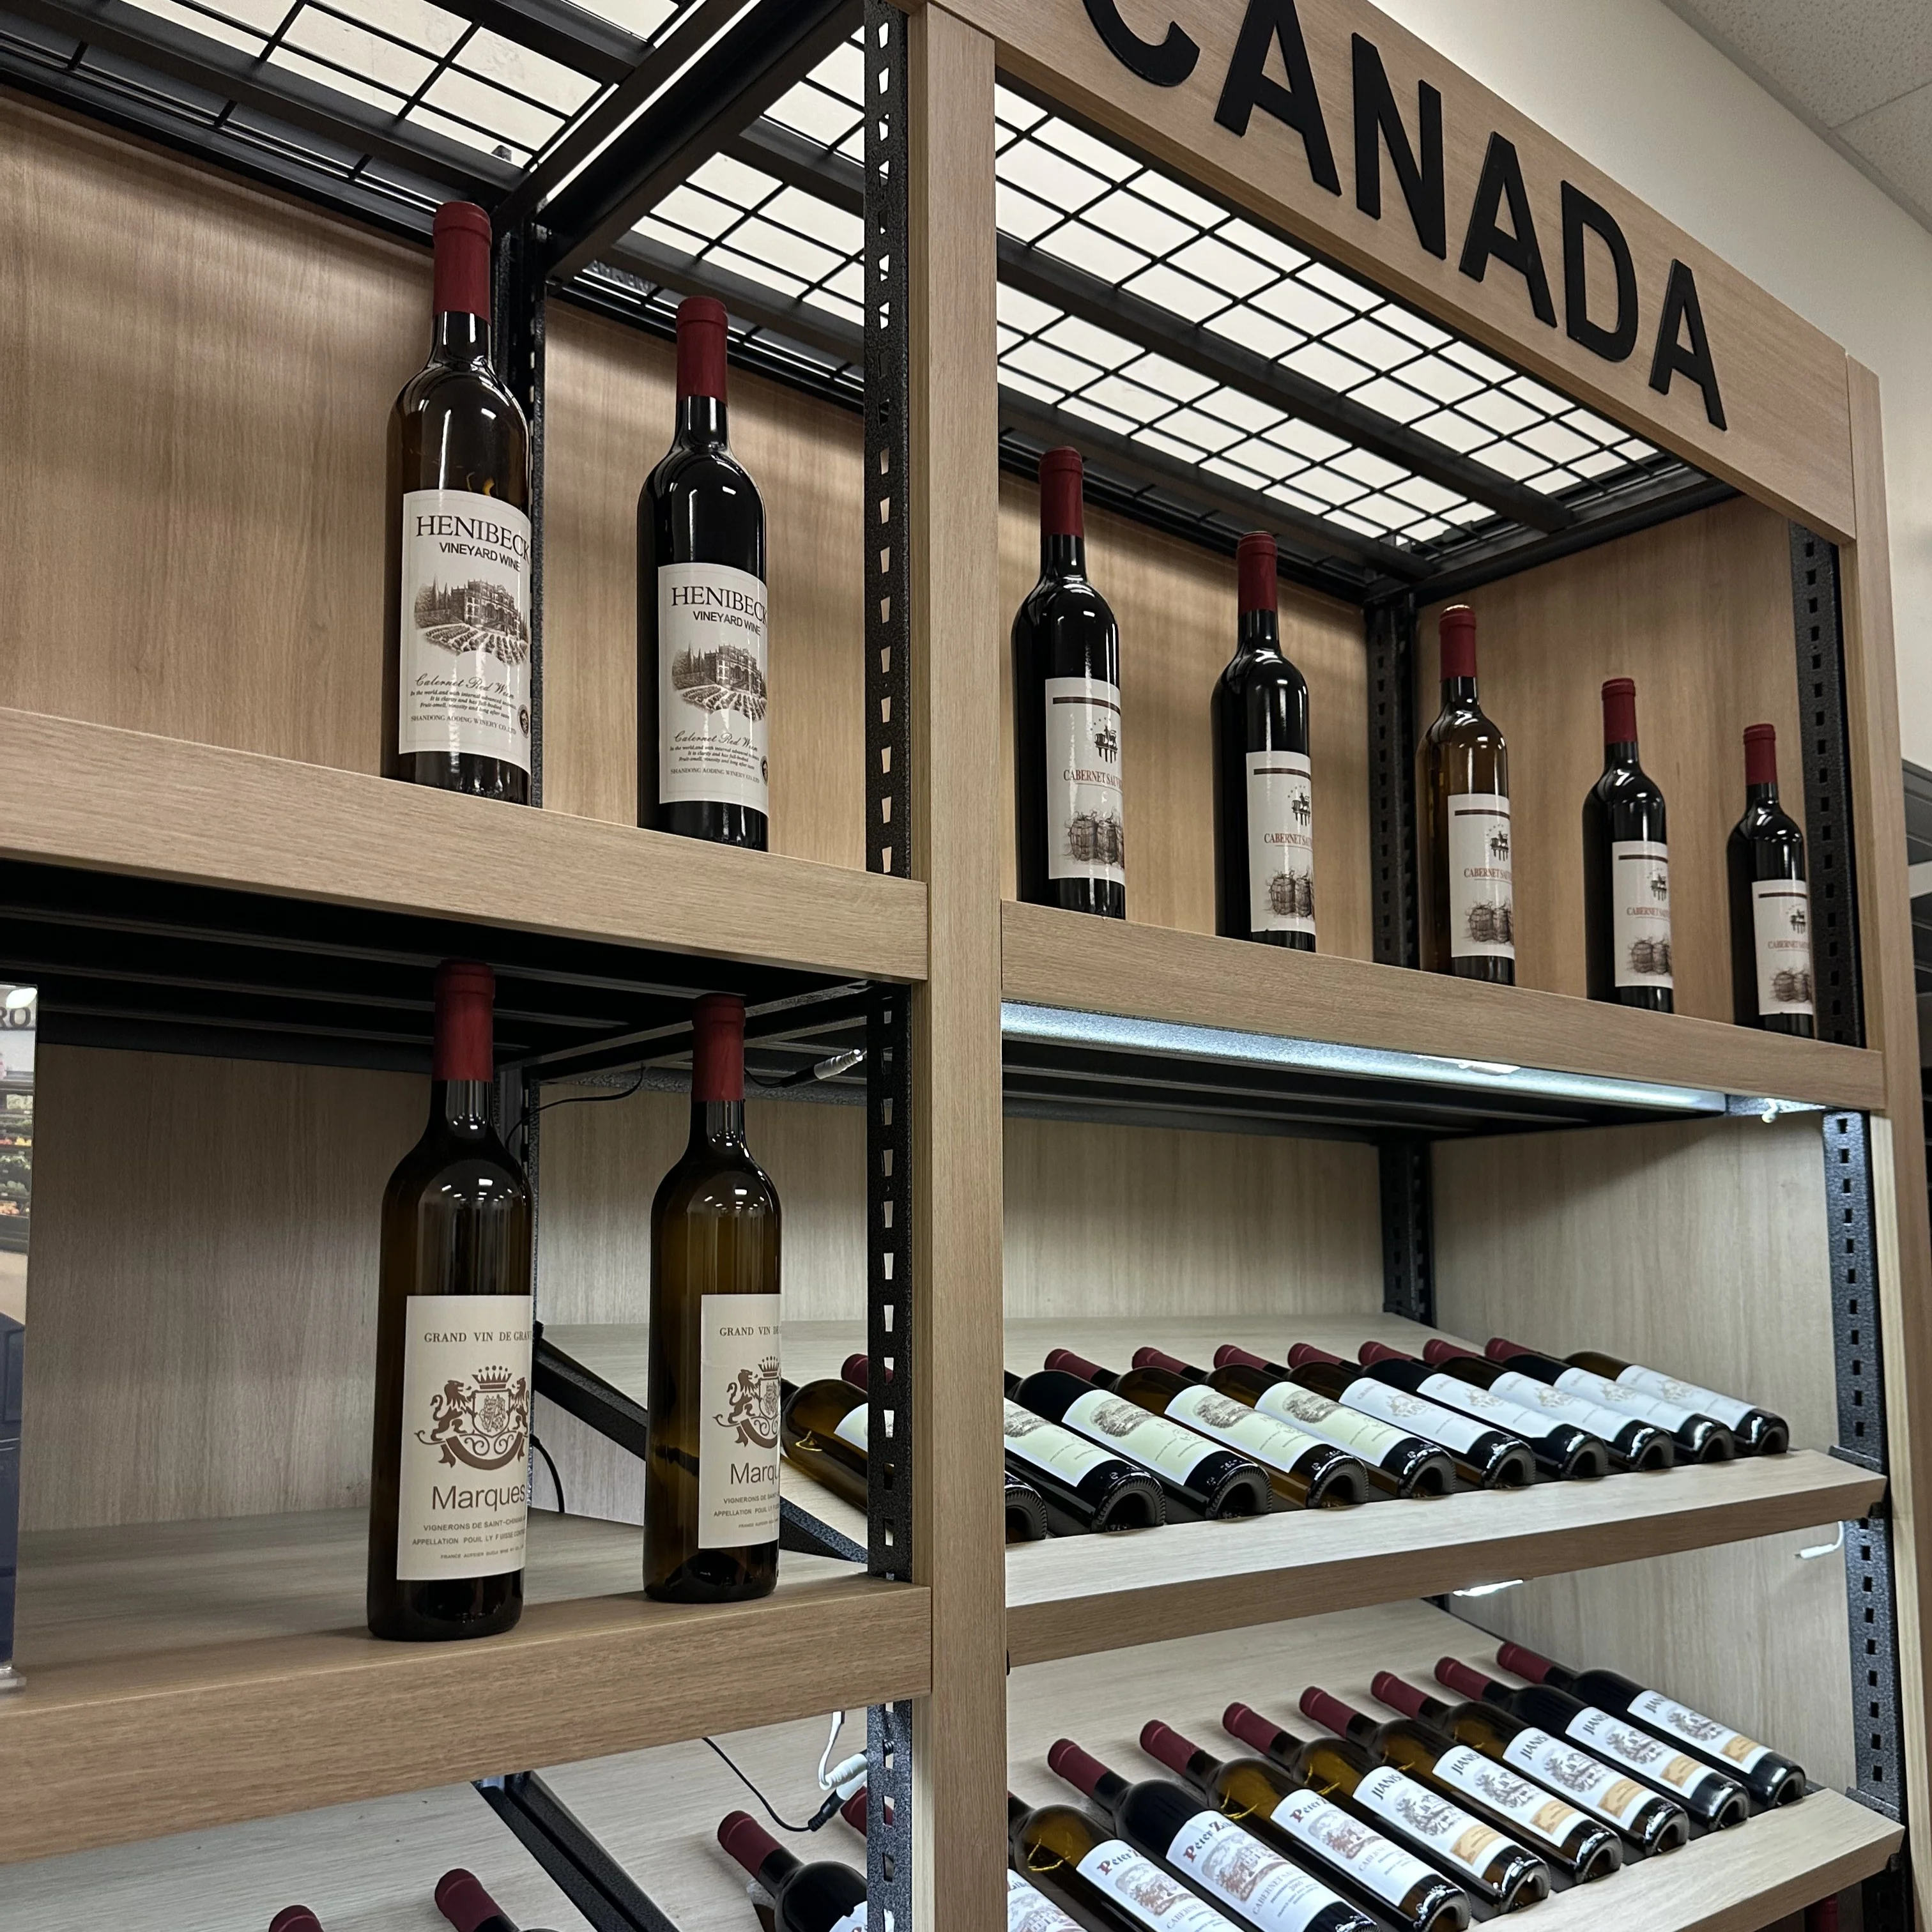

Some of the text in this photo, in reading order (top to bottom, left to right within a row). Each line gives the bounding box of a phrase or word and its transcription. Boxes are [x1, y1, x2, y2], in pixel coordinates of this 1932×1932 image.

[416, 515, 530, 564] HENIBECK
[439, 542, 521, 572] VINEYARD WINE
[671, 586, 767, 627] HENIBECK
[693, 611, 761, 636] VINEYARD WINE
[466, 677, 494, 691] Red
[718, 732, 742, 746] Red
[1063, 769, 1105, 783] CABERNET
[1264, 832, 1301, 845] CABERNET
[1464, 868, 1499, 878] CABERNET
[424, 1332, 467, 1342] GRAND
[473, 1331, 493, 1342] VIN
[499, 1331, 511, 1341] DE
[719, 1327, 754, 1336] GRAND
[758, 1326, 770, 1335] VIN
[432, 1484, 525, 1512] Marques
[723, 1496, 759, 1504] VIGNERONS
[714, 1508, 751, 1517] APPELLATION
[424, 1523, 470, 1531] VIGNERONS
[1183, 1830, 1213, 1863] Peter
[1096, 1852, 1131, 1875] Peter
[1252, 1876, 1283, 1915] CABERNET
